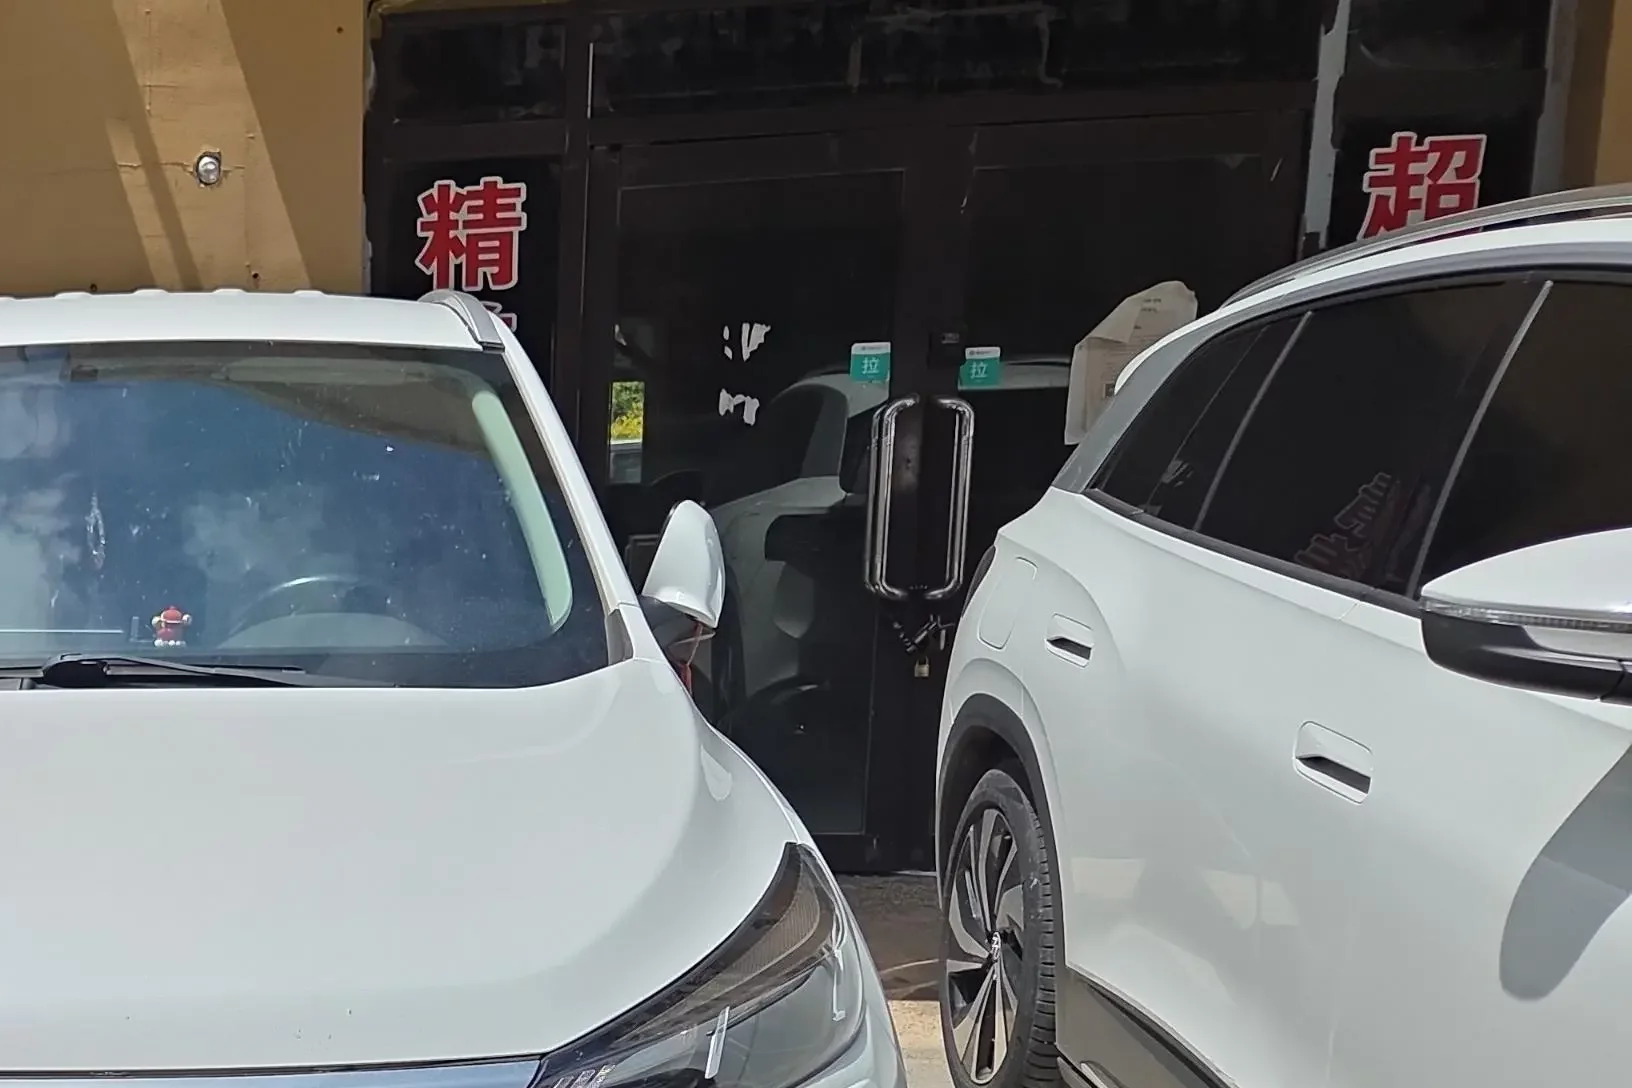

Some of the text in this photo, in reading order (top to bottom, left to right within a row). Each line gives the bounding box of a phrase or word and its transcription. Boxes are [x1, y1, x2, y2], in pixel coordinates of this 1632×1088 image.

[1357, 131, 1487, 240] 超
[861, 357, 880, 375] 拉
[970, 361, 988, 379] 拉
